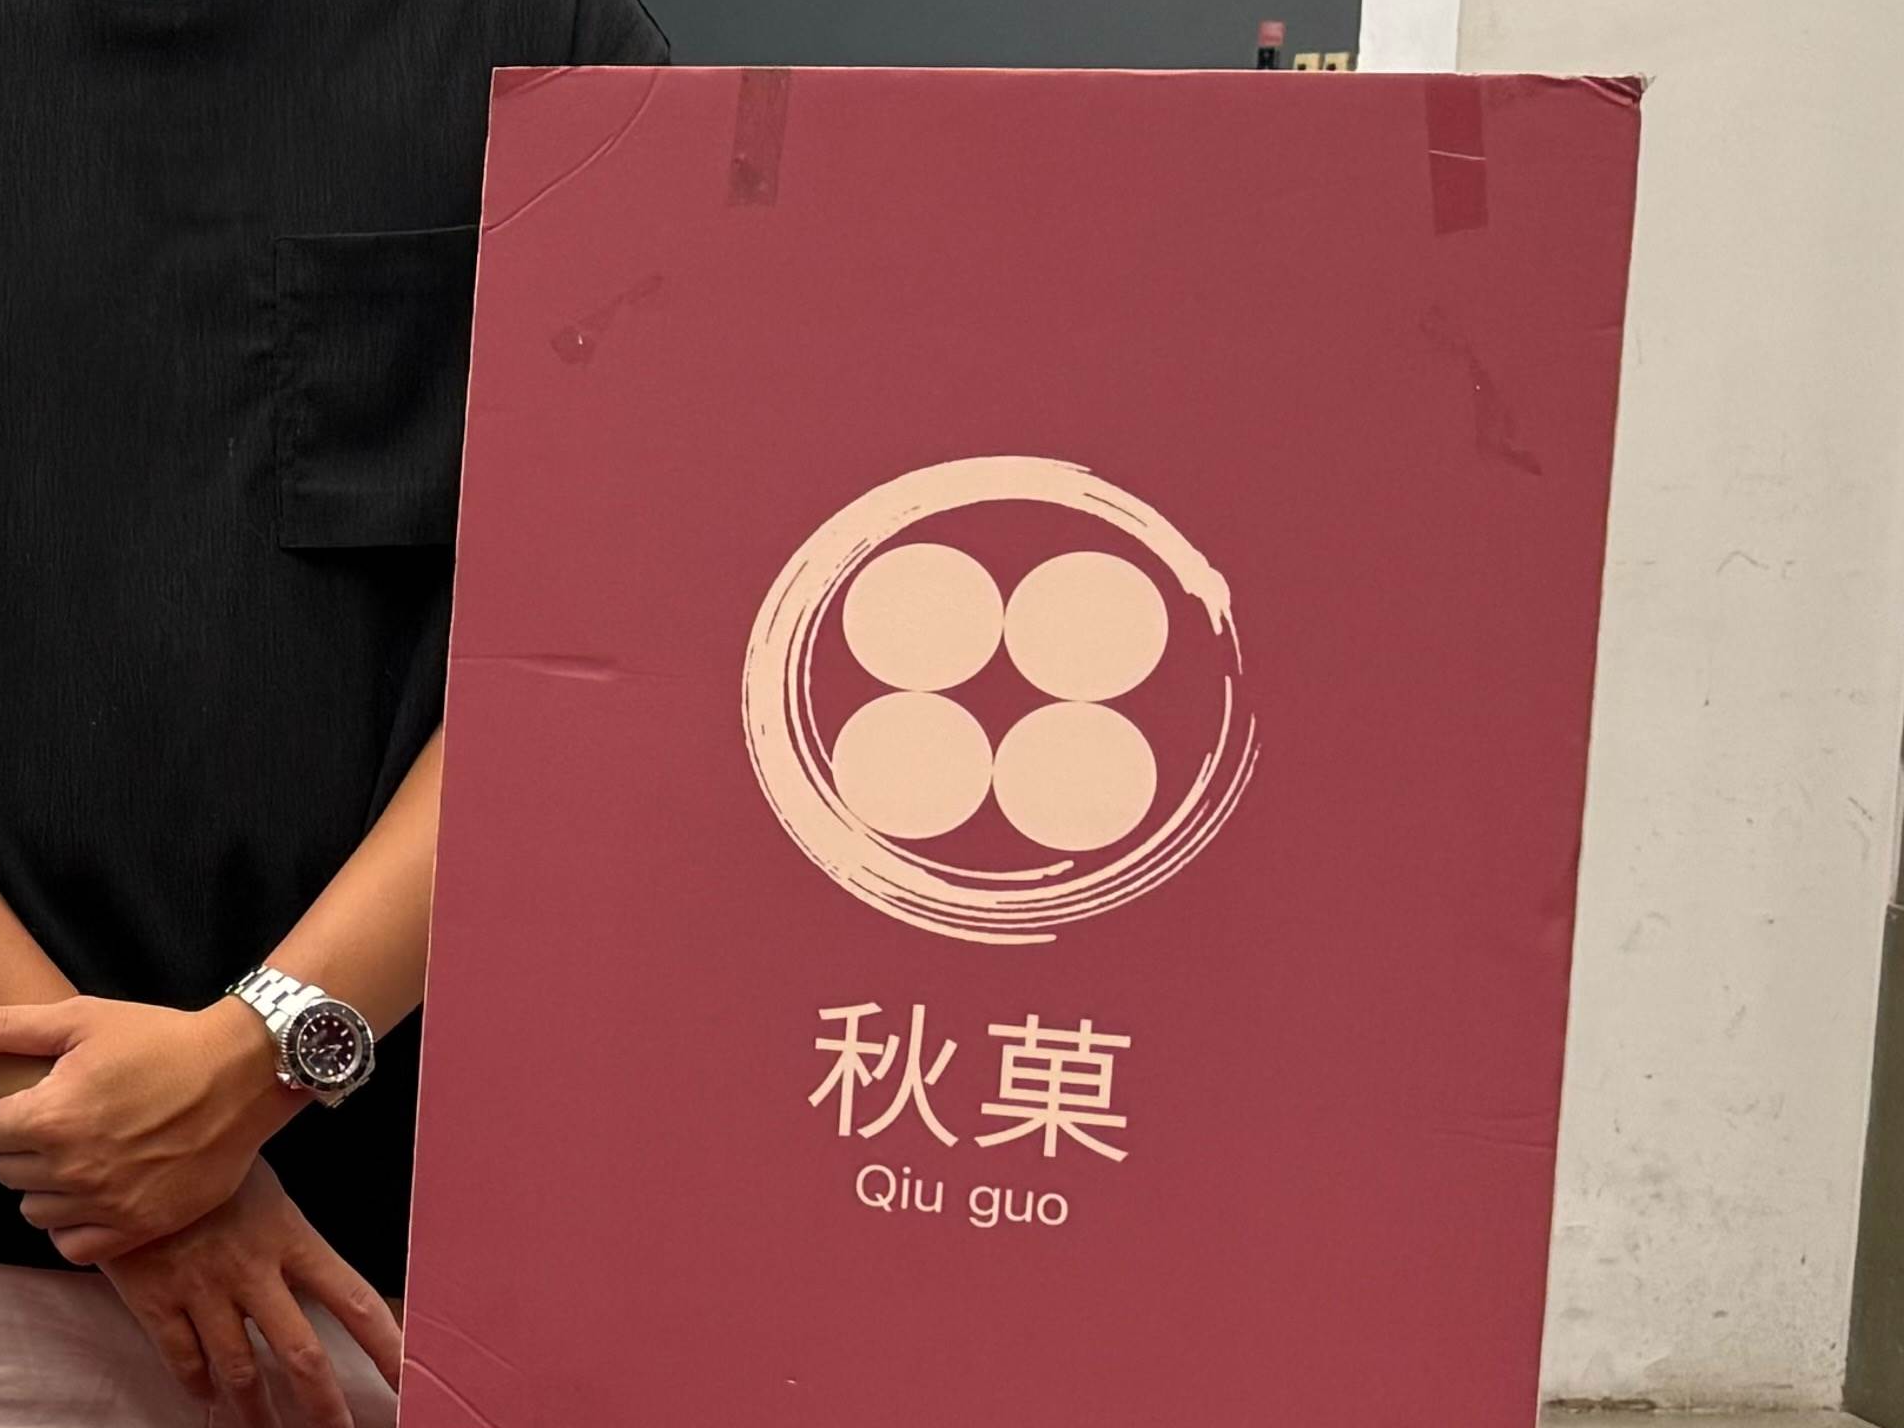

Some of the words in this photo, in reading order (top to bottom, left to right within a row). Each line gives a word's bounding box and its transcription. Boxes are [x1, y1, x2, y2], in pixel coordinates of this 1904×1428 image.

[808, 1002, 1131, 1162] 秋菓
[855, 1164, 944, 1213] Qiu
[967, 1185, 1069, 1228] guo
